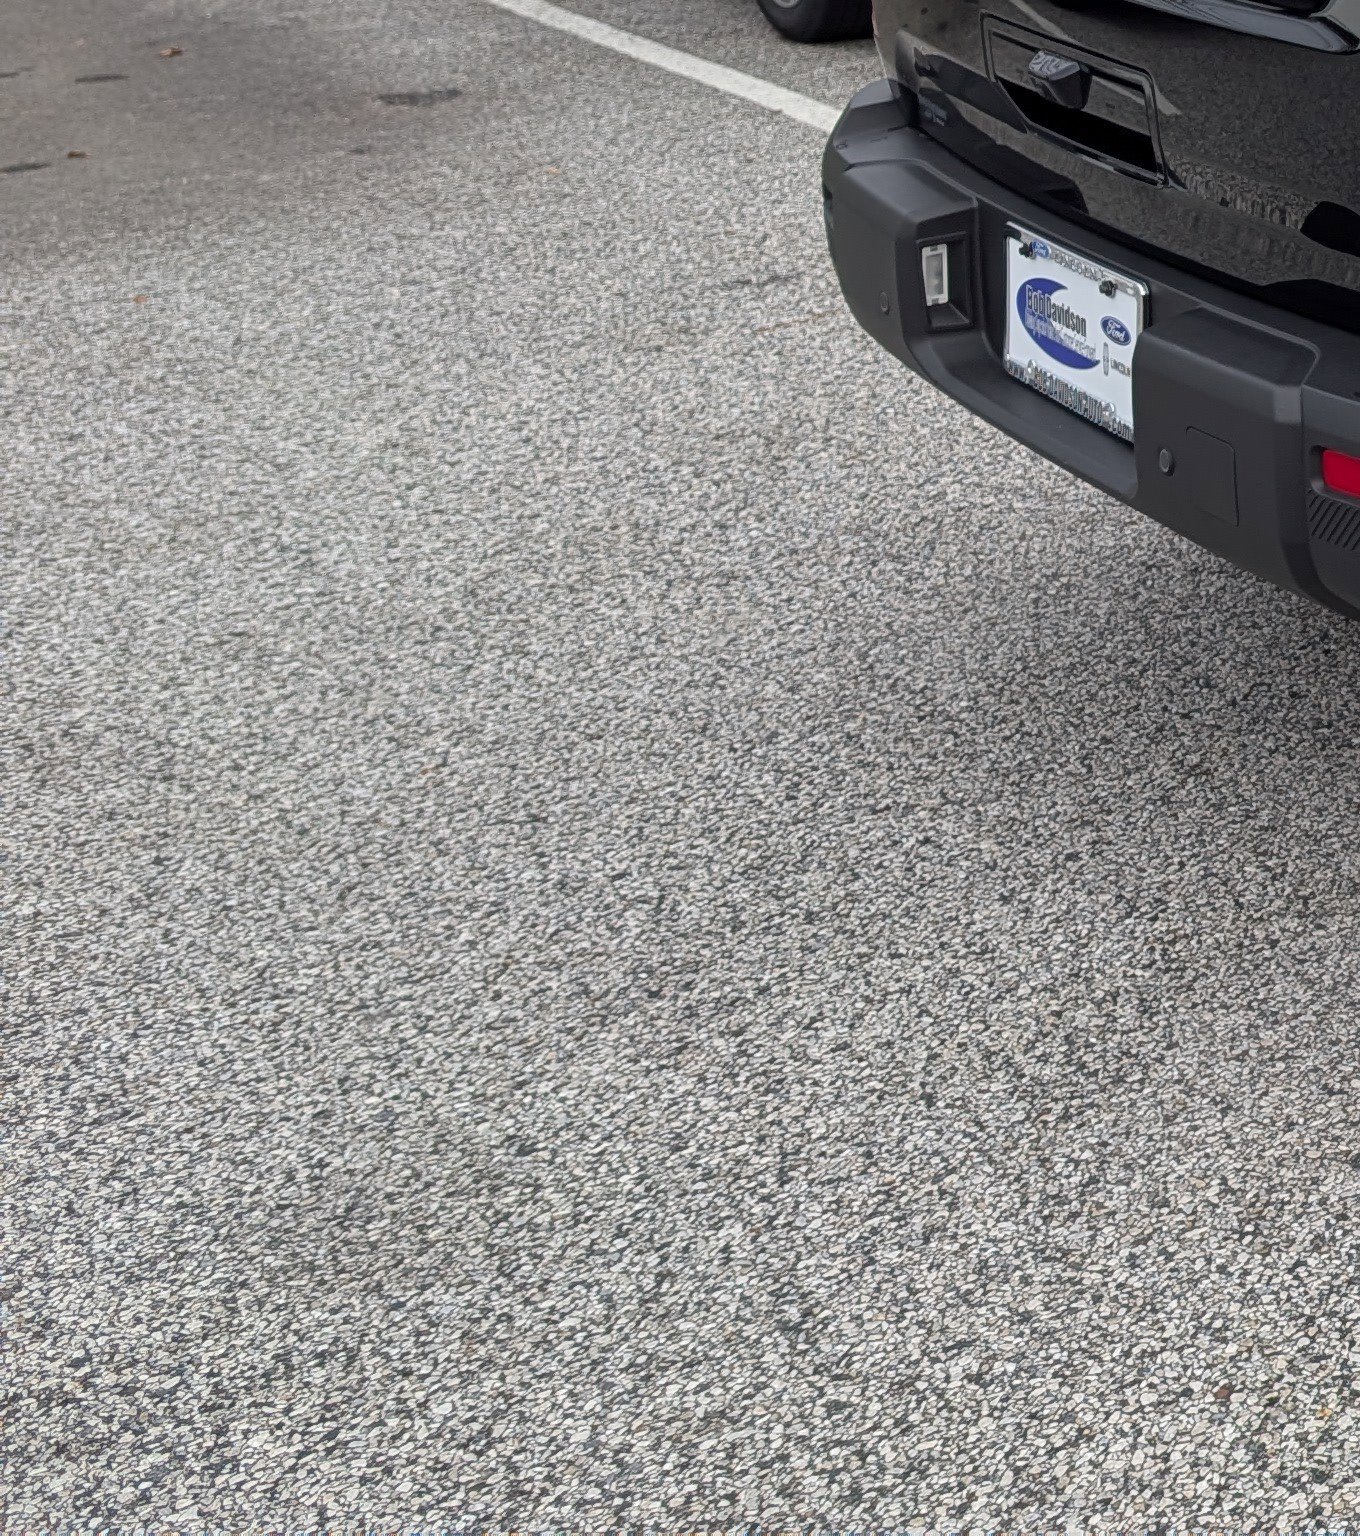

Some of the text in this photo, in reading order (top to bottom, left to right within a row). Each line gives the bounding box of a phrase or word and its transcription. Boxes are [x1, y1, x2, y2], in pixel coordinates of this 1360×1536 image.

[1026, 284, 1045, 315] Bob
[1045, 294, 1087, 338] Davidson
[1104, 318, 1128, 342] Ford
